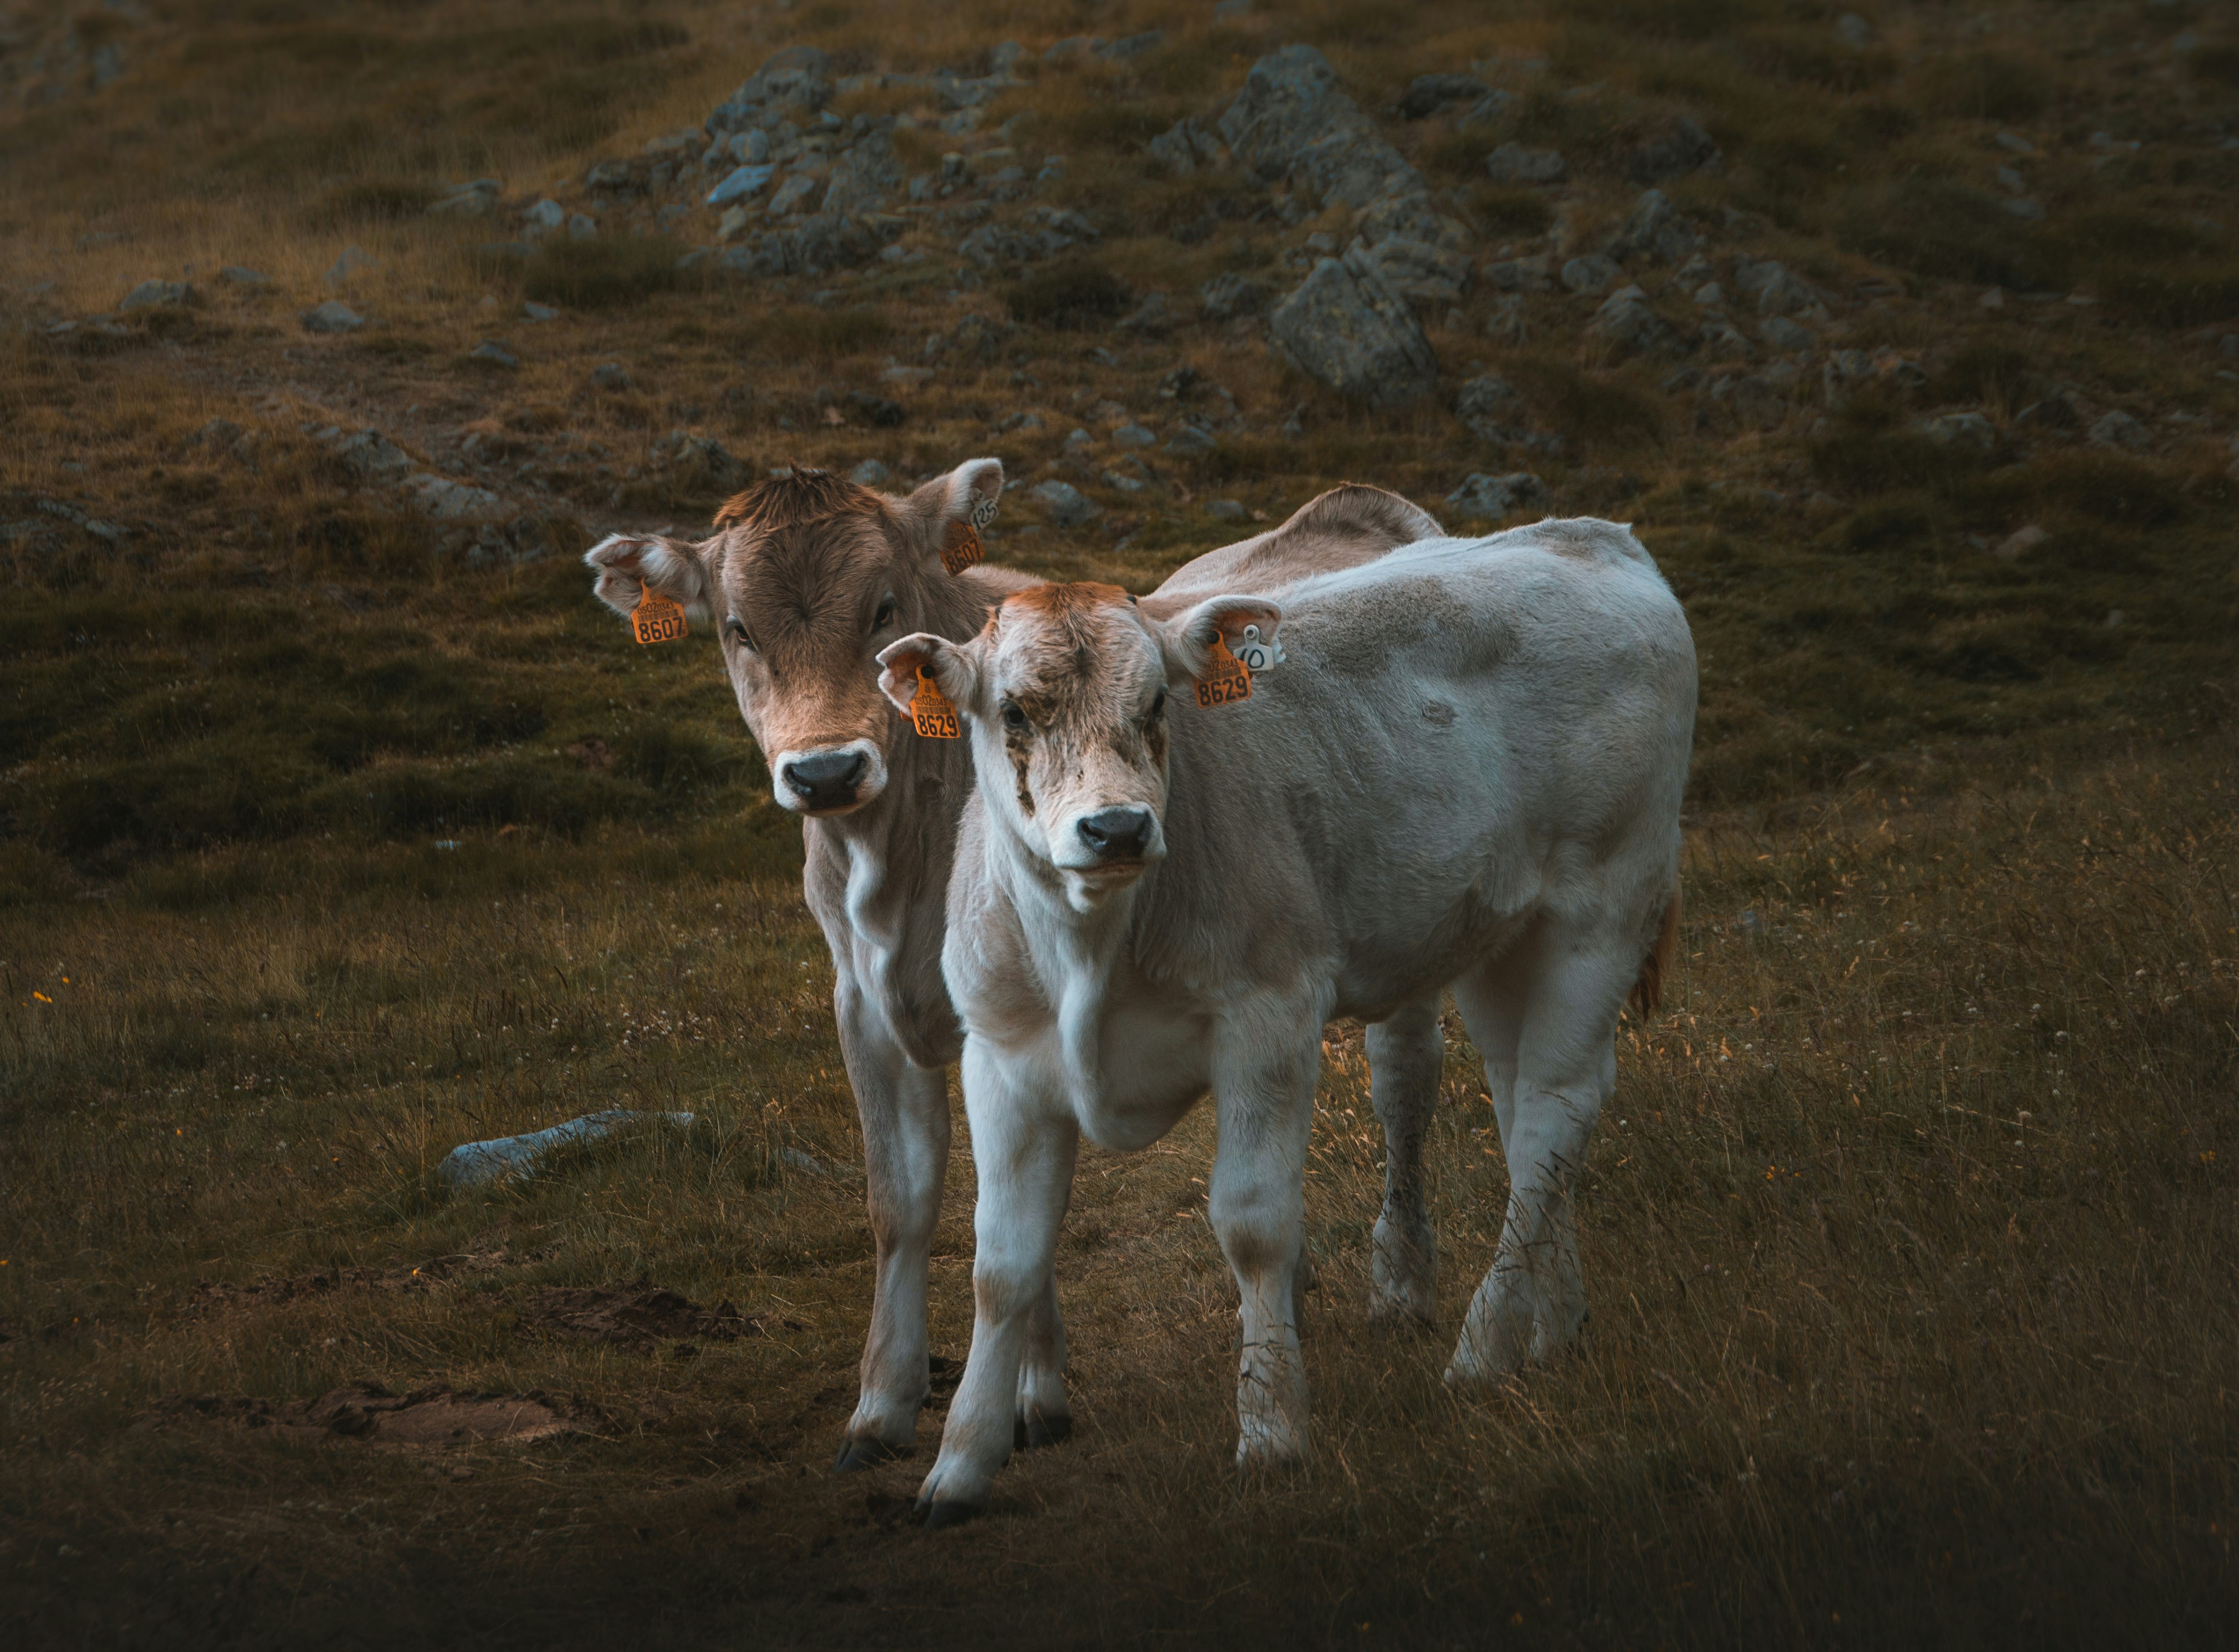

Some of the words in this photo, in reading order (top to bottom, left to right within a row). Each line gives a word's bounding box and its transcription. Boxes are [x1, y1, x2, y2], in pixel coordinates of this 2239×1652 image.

[973, 499, 997, 530] 125
[945, 538, 980, 575] 8607
[639, 617, 683, 642] 8607
[1198, 675, 1248, 706] 8629
[917, 714, 958, 736] 8629
